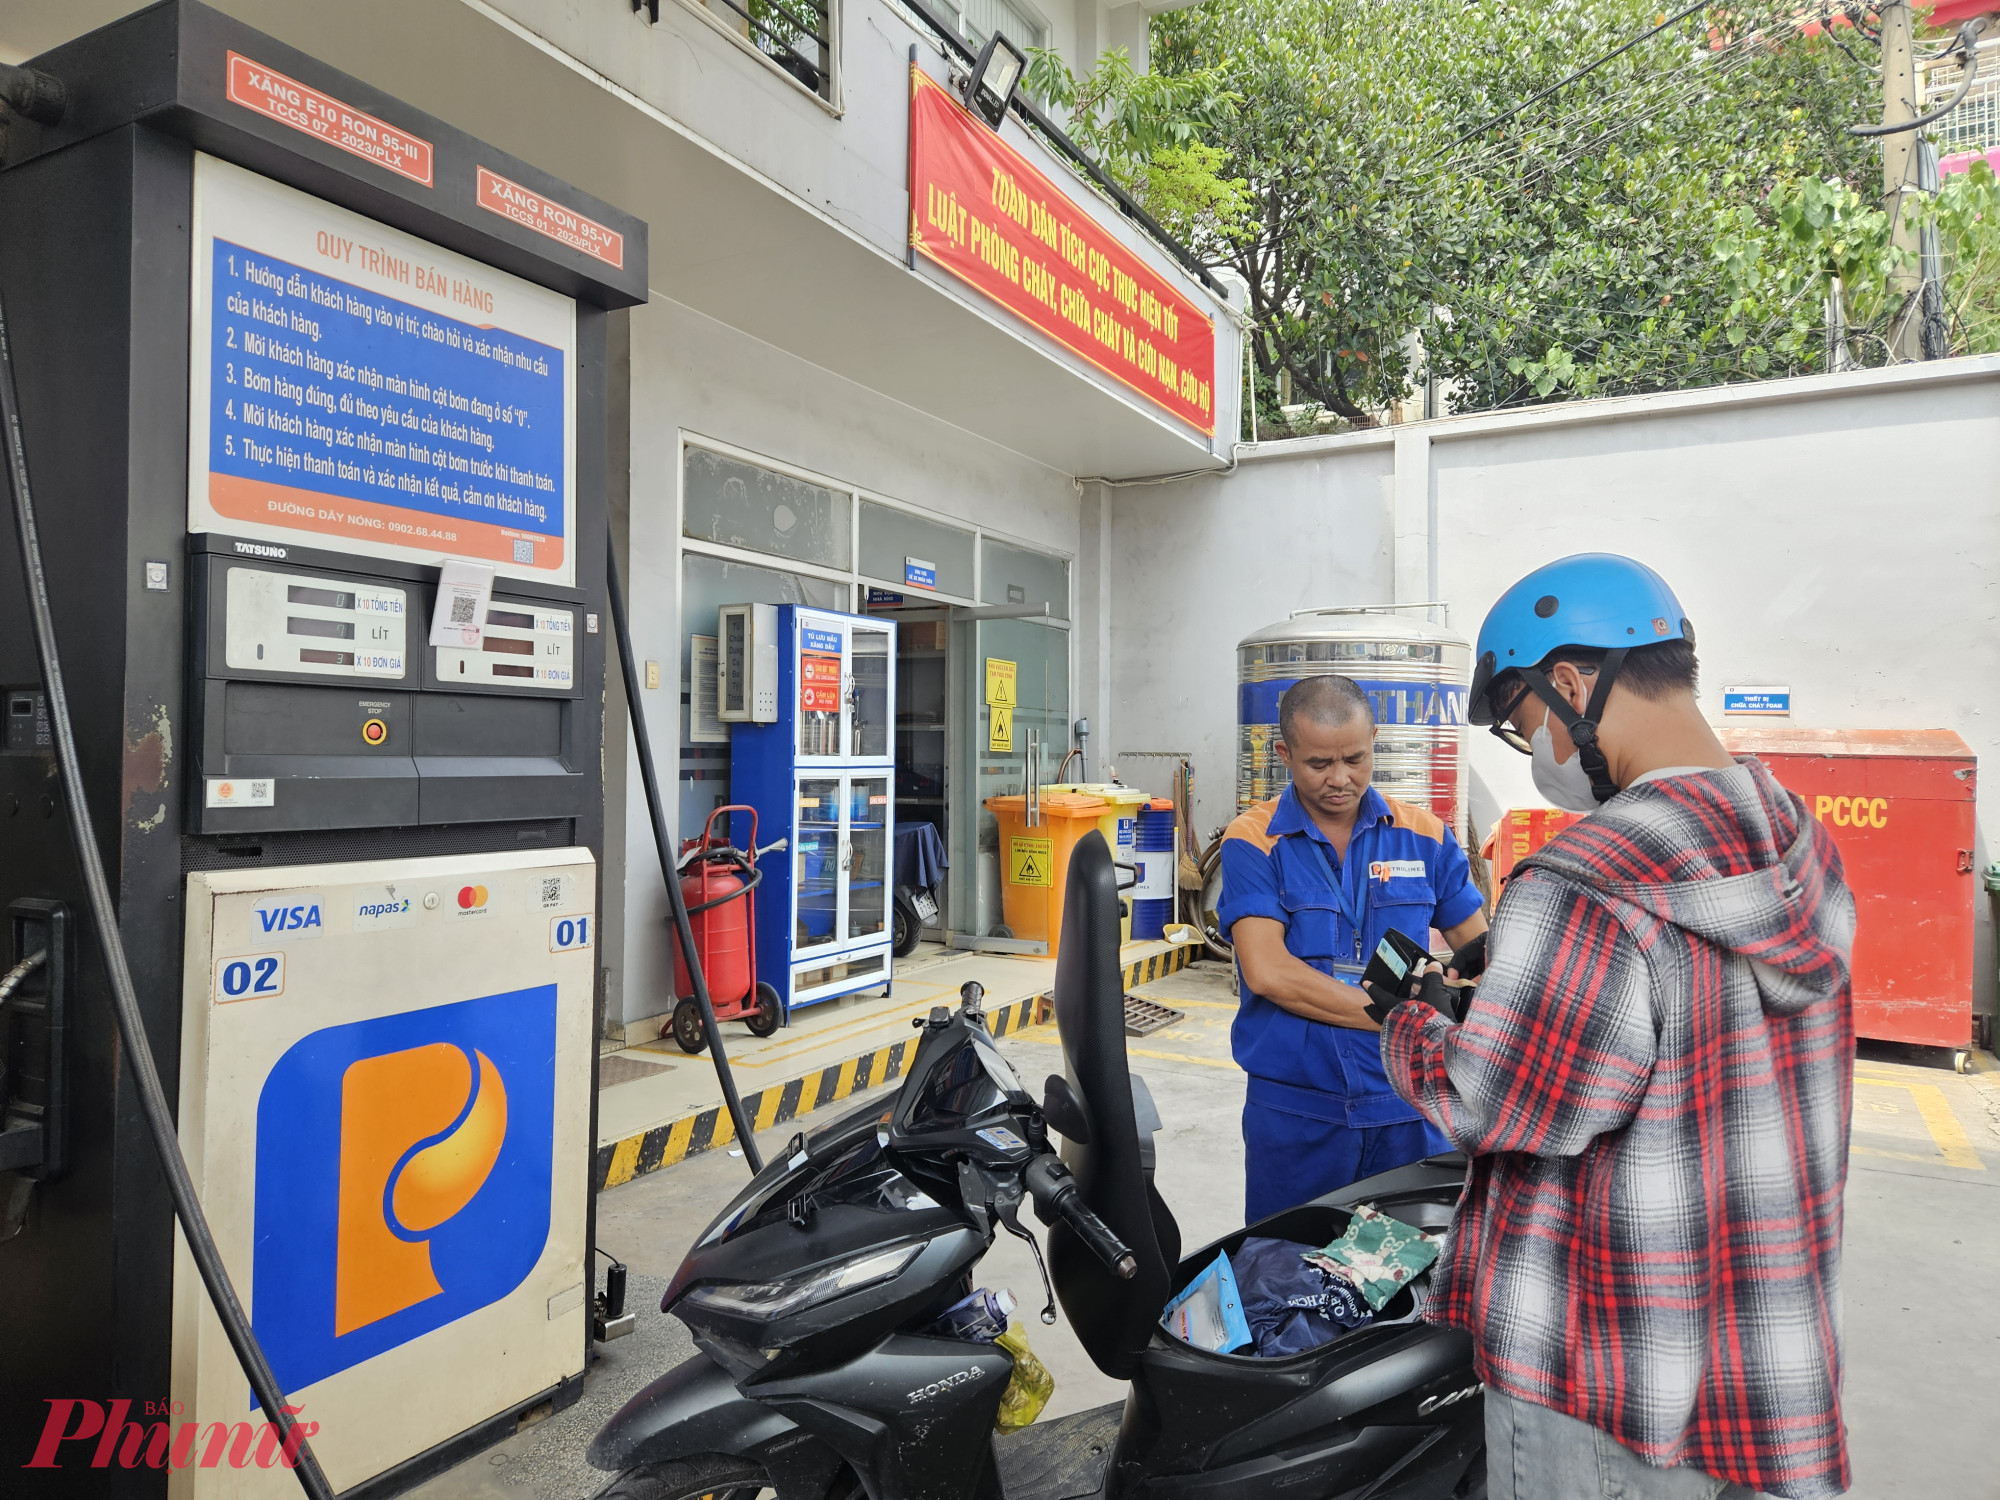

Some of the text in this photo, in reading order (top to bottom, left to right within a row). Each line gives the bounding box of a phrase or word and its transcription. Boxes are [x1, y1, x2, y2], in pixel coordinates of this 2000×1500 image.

[248, 71, 418, 160] XĂNG E10 RON 95-III
[267, 98, 308, 125] TCCS
[313, 121, 329, 134] 07
[341, 131, 402, 167] 2023/PLX
[491, 180, 612, 247] XĂNG RON 95-V
[504, 203, 534, 225] TCCS
[537, 218, 547, 231] 01
[557, 228, 600, 255] 2023/PLX
[317, 231, 493, 314] QUY TRÌNH BÁN HÀNG
[992, 166, 1179, 344] TOÀN DÂN TÍCH CỰC THỰC HIỆN TỐT
[227, 291, 322, 342] của khách hàng.
[228, 255, 548, 376] 1. Hướng dẫn khách hàng vào vị trí; chào hỏi và xác nhận nhu cầu
[928, 182, 1211, 419] LUẬT PHÒNG CHÁY, CHỮA CHÁY VÀ CỨU NẠN, CỨU HỘ
[226, 326, 238, 349] 2.
[244, 331, 265, 357] Mời
[269, 338, 303, 367] khách
[306, 349, 333, 380] hàng
[336, 360, 355, 381] xác
[358, 366, 383, 391] nhận
[386, 374, 407, 395] màn
[409, 378, 430, 401] hình
[433, 387, 447, 409] cột
[449, 390, 468, 412] bơm
[471, 397, 492, 423] đang
[495, 401, 500, 420] ở
[502, 405, 512, 424] số
[226, 363, 494, 452] 3. Bơm hàng đúng, đủ theo yêu cầu của khách hàng.
[226, 399, 555, 492] 4. Mời khách hàng xác nhận màn hình cột bơm trước khi thanh toán.
[225, 435, 547, 523] 5. Thực hiện thanh toán và xác nhận kết quả, cảm ơn khách hàng.
[267, 501, 457, 542] ĐƯỜNG DÂY NÓNG: 0902.68.44.88
[235, 542, 287, 559] TATSUNO
[356, 597, 362, 609] X
[363, 597, 370, 610] 10
[371, 593, 388, 612] TỔNG
[372, 626, 389, 641] LÍT
[547, 644, 561, 656] LÍT
[356, 654, 402, 670] X 10 ĐƠN GIÁ
[358, 701, 391, 709] EMERGENCY
[1815, 795, 1888, 829] PCCC
[254, 905, 322, 933] VISA
[359, 902, 400, 918] napas
[458, 908, 487, 917] mastercard
[556, 917, 587, 947] 01
[223, 957, 279, 996] 02
[907, 1365, 985, 1404] HONDA
